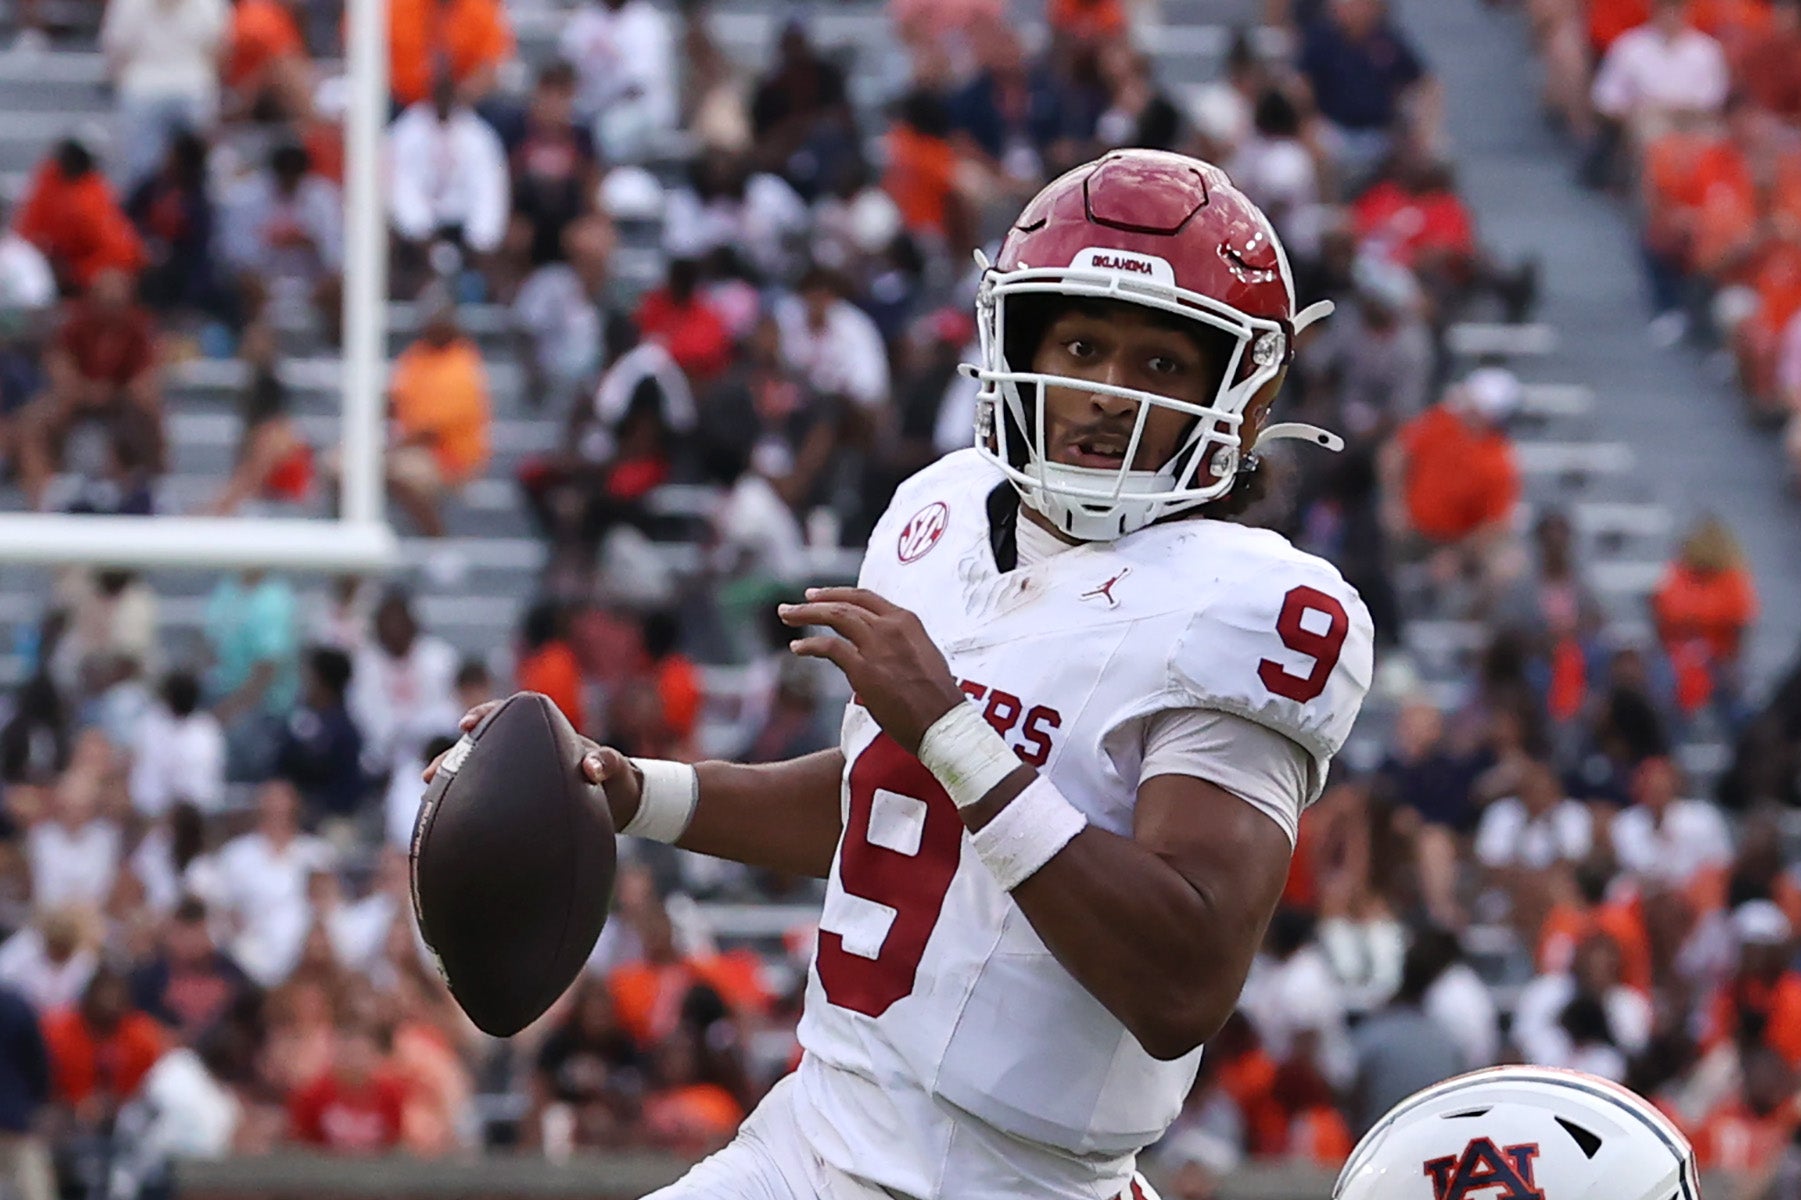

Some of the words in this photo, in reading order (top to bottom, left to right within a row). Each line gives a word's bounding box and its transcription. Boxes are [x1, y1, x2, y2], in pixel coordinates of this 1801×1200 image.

[1092, 254, 1152, 276] OKLAHOMA
[1257, 585, 1349, 704] 9
[816, 731, 964, 1018] 9
